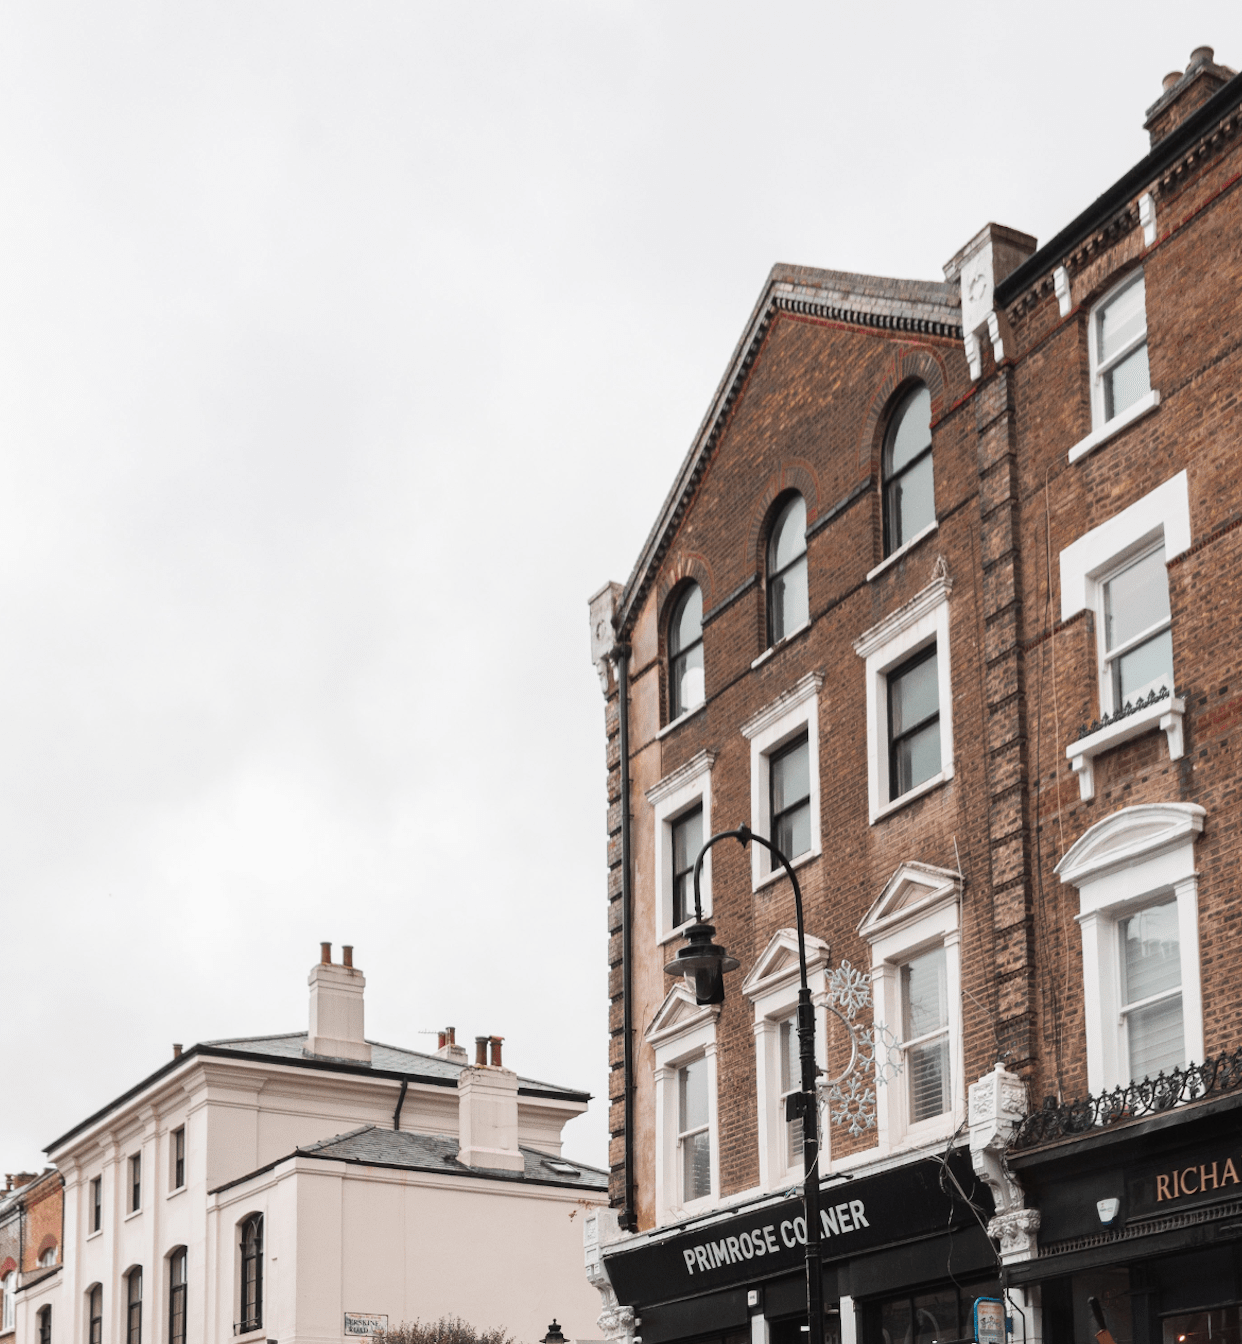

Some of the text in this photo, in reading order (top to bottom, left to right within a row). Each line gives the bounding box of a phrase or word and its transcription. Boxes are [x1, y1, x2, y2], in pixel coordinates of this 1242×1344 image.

[1156, 1157, 1242, 1202] RICHA
[683, 1199, 870, 1275] PRIMROSE CONER
[348, 1318, 380, 1327] ERSKINE
[349, 1326, 369, 1334] ROAD
